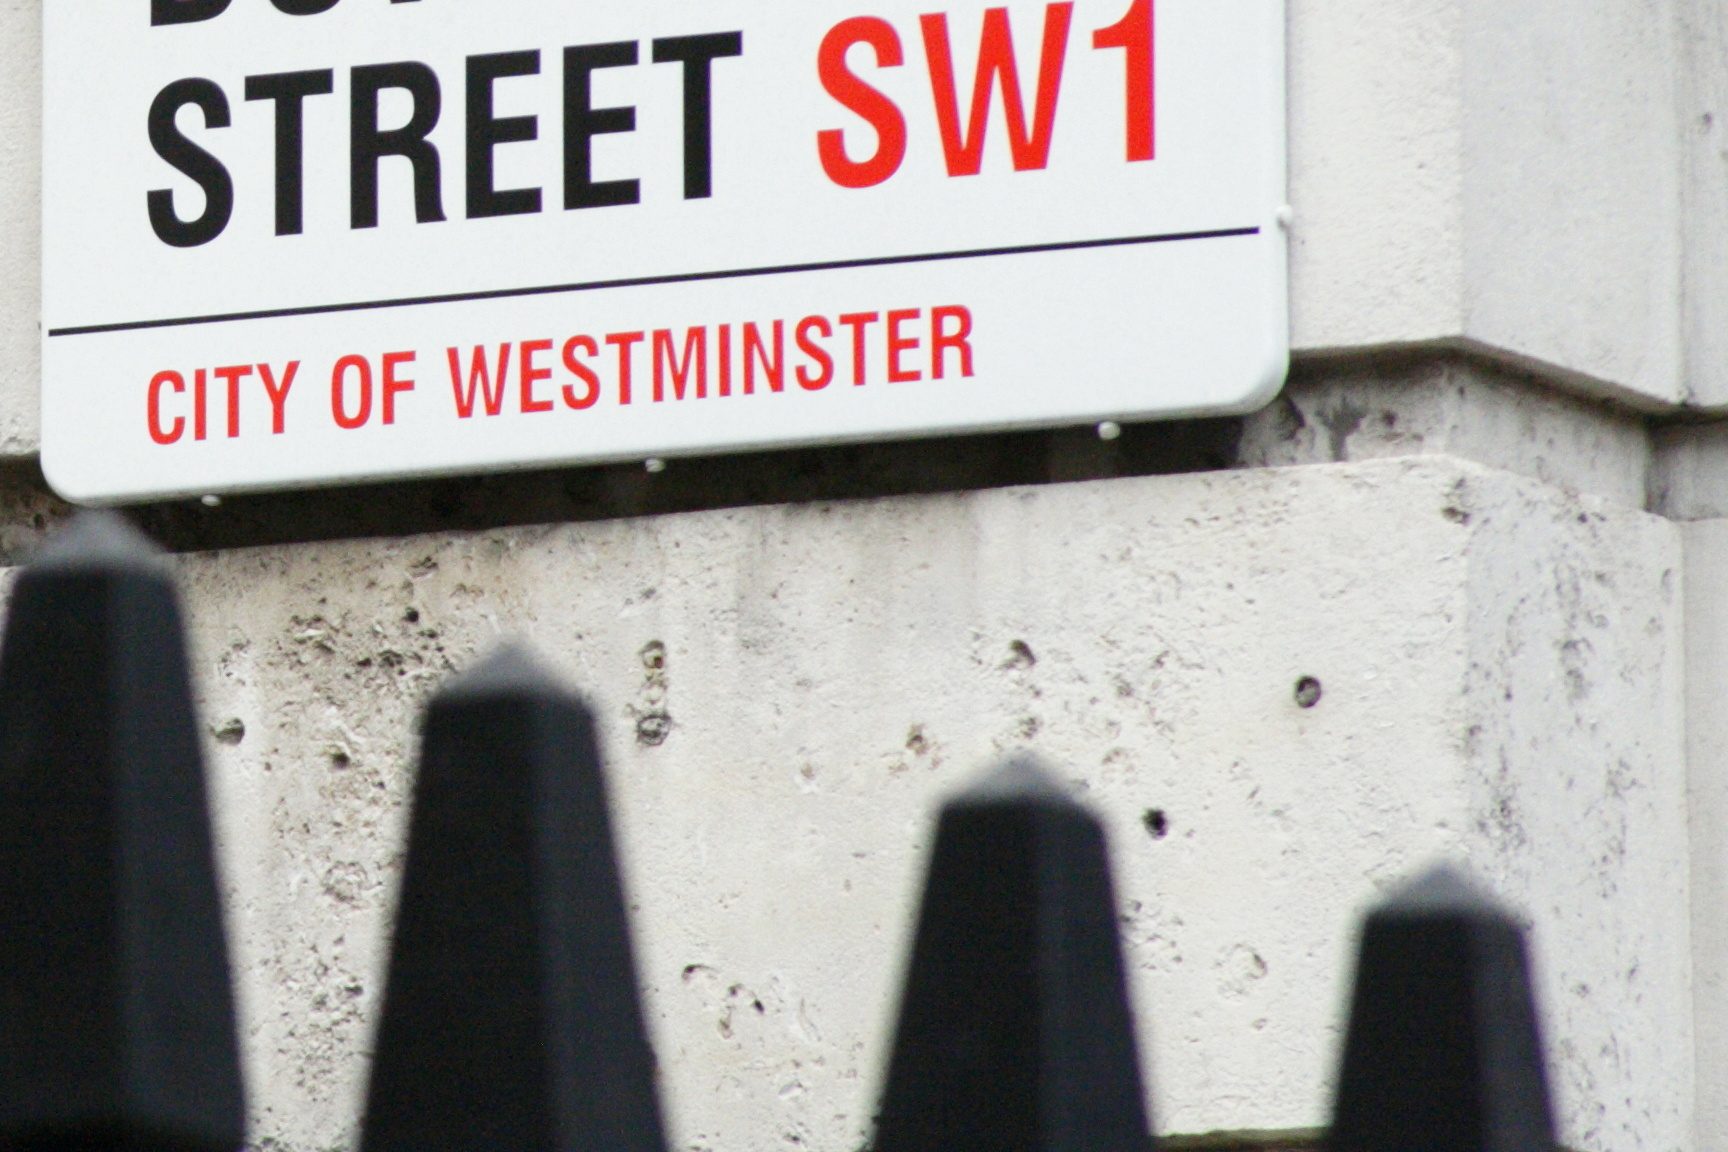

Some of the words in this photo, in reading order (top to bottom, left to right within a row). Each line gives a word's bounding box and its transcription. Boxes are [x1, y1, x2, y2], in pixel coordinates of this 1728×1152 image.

[146, 30, 743, 248] STREET
[147, 360, 300, 445] CITY
[331, 350, 417, 430] OF
[446, 305, 975, 419] WESTMINSTER
